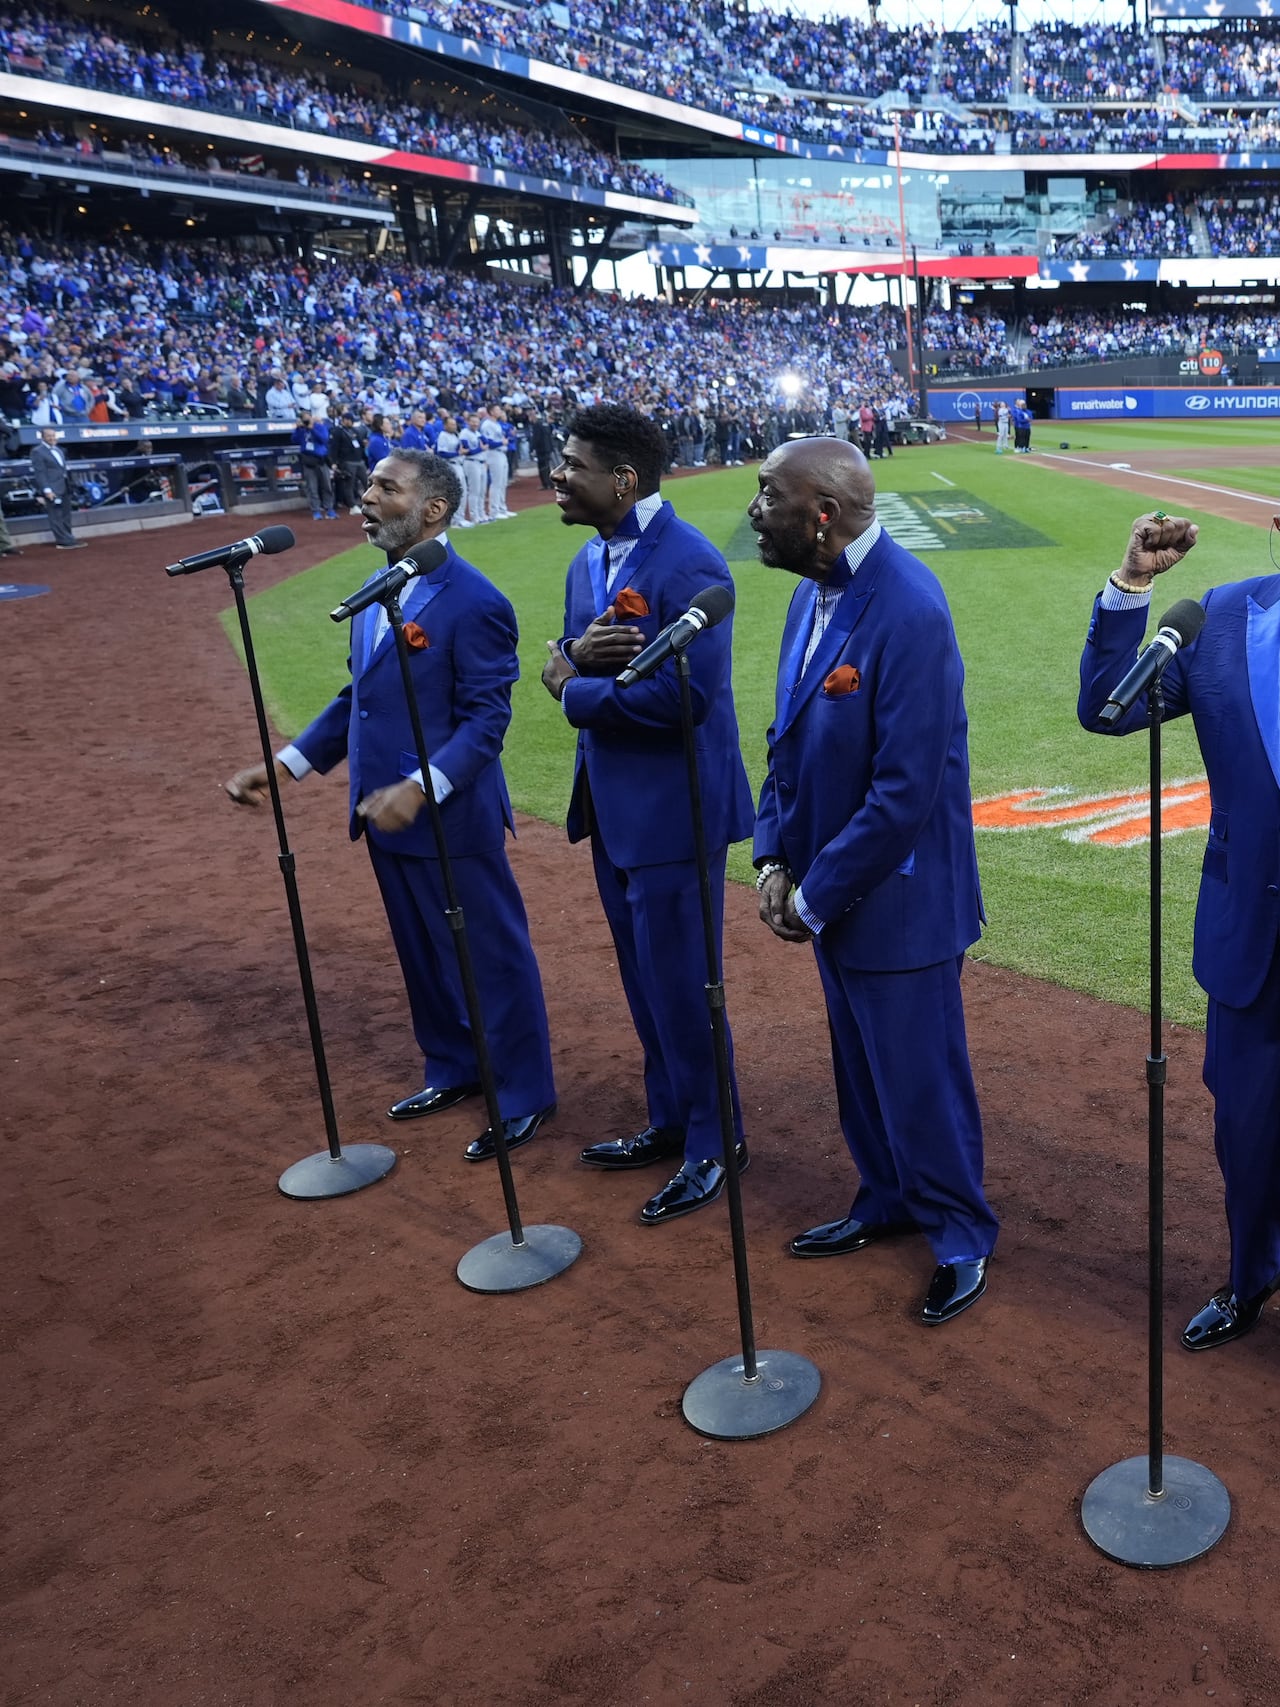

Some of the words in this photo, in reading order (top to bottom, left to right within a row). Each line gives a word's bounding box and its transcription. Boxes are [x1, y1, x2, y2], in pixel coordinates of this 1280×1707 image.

[1179, 359, 1198, 371] citi
[1202, 358, 1220, 368] 110
[1071, 398, 1124, 411] smartwater
